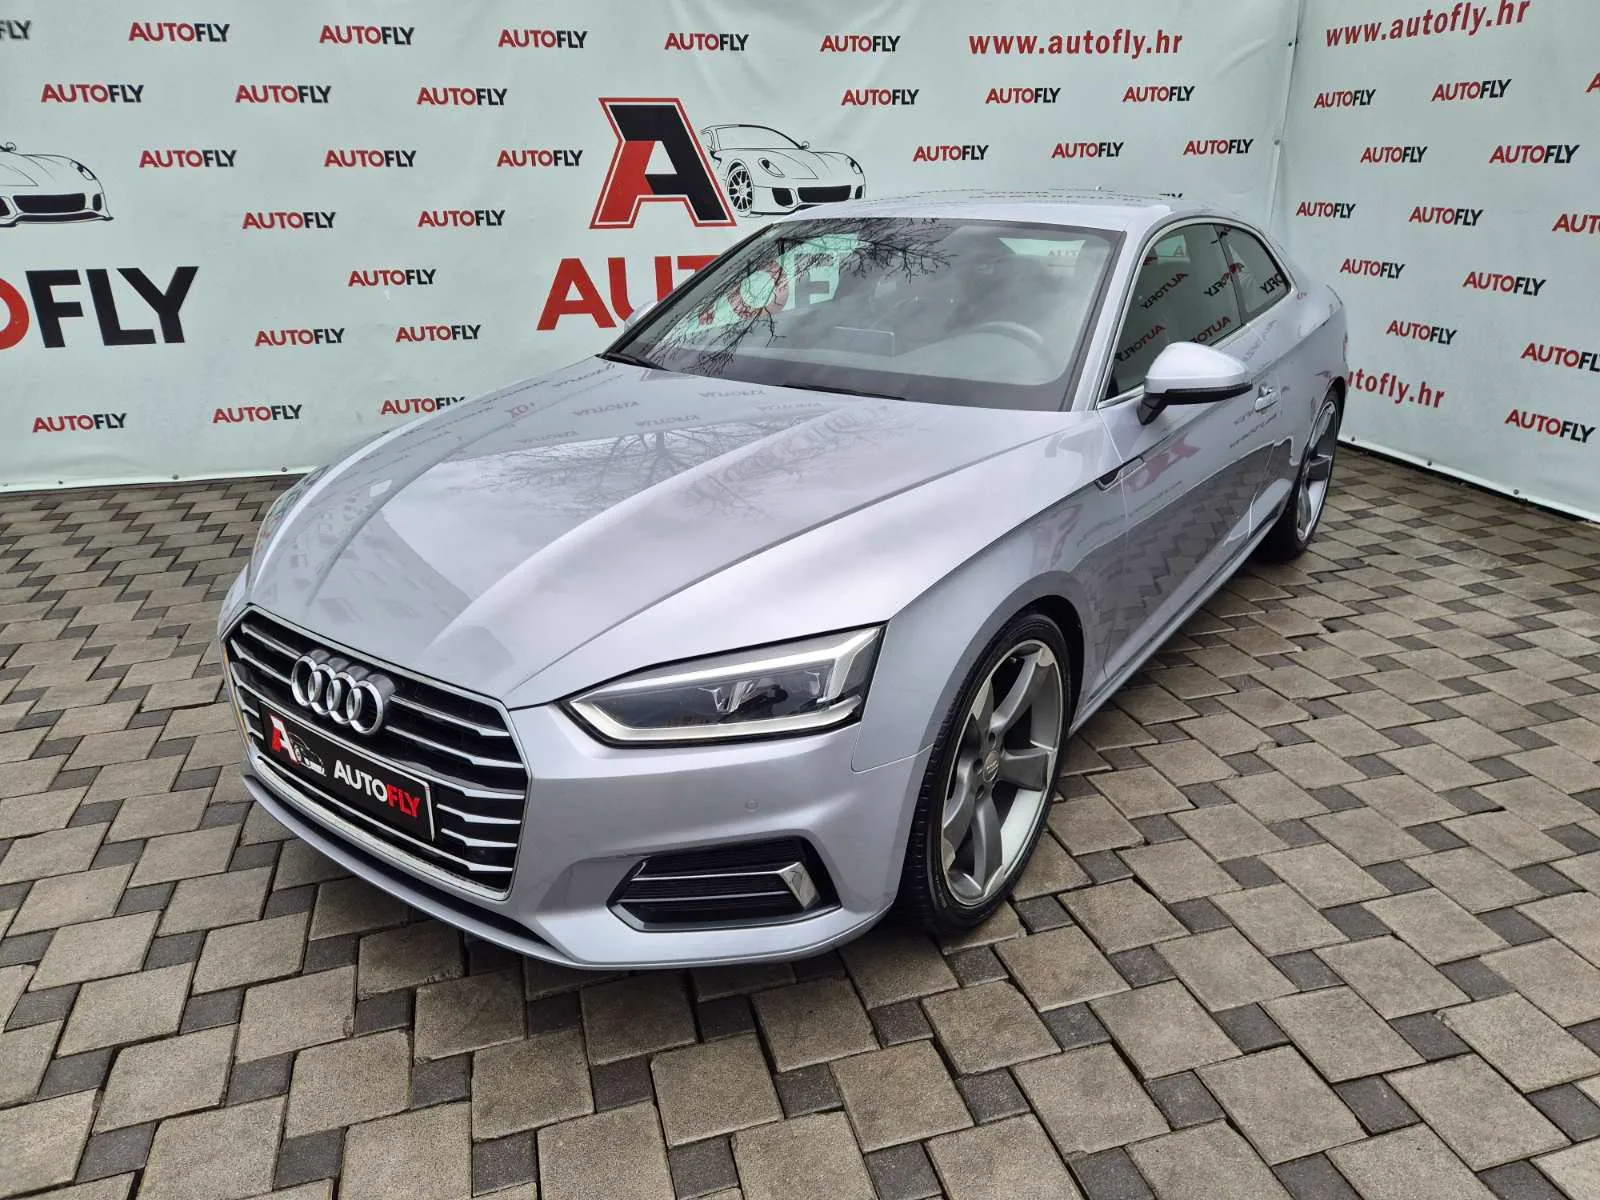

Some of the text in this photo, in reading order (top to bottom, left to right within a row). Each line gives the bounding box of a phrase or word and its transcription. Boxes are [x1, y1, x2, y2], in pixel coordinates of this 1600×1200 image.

[129, 22, 230, 42] AUTOFLY
[1327, 0, 1530, 47] www.autofly.hr
[320, 25, 414, 45] AUTOFLY
[498, 29, 588, 48] AUTOFLY
[664, 33, 749, 51] AUTOFLY
[820, 35, 901, 52] AUTOFLY
[969, 29, 1182, 59] www.autofly.hr
[41, 84, 144, 103] AUTOFLY
[236, 85, 331, 103] AUTOFLY
[417, 87, 507, 105] AUTOFLY
[841, 89, 919, 106] AUTOFLY
[985, 88, 1061, 104] AUTOFLY
[1123, 86, 1195, 102] AUTOFLY
[1314, 89, 1376, 108] AUTOFLY
[1432, 79, 1512, 101] AUTOFLY
[913, 145, 989, 162] AUTOFLY
[1051, 142, 1124, 158] AUTOFLY
[1183, 139, 1254, 155] AUTOFLY
[1360, 146, 1427, 163] AUTOFLY
[1489, 145, 1580, 163] AUTOFLY
[139, 150, 237, 168] AUTOFLY
[324, 150, 416, 167] AUTOFLY
[497, 150, 583, 167] AUTOFLY
[418, 210, 505, 227] AUTOFLY
[1296, 202, 1356, 218] AUTOFLY
[1409, 207, 1483, 226] AUTOFLY
[243, 212, 336, 229] AUTOFLY
[1552, 214, 1600, 234] AUT
[348, 269, 436, 287] AUTOFLY
[1340, 259, 1405, 279] AUTOFLY
[1462, 272, 1546, 296] AUTOFLY
[255, 328, 344, 347] AUTOFLY
[396, 325, 481, 342] AUTOFLY
[1386, 320, 1457, 345] AUTOFLY
[1521, 343, 1600, 372] AUTOFL
[1346, 369, 1445, 408] tofly.hr
[213, 404, 302, 423] AUTOFLY
[33, 413, 126, 433] AUTOFLY
[1505, 409, 1596, 443] AUTOFLY
[334, 760, 422, 818] AUTOFLY
